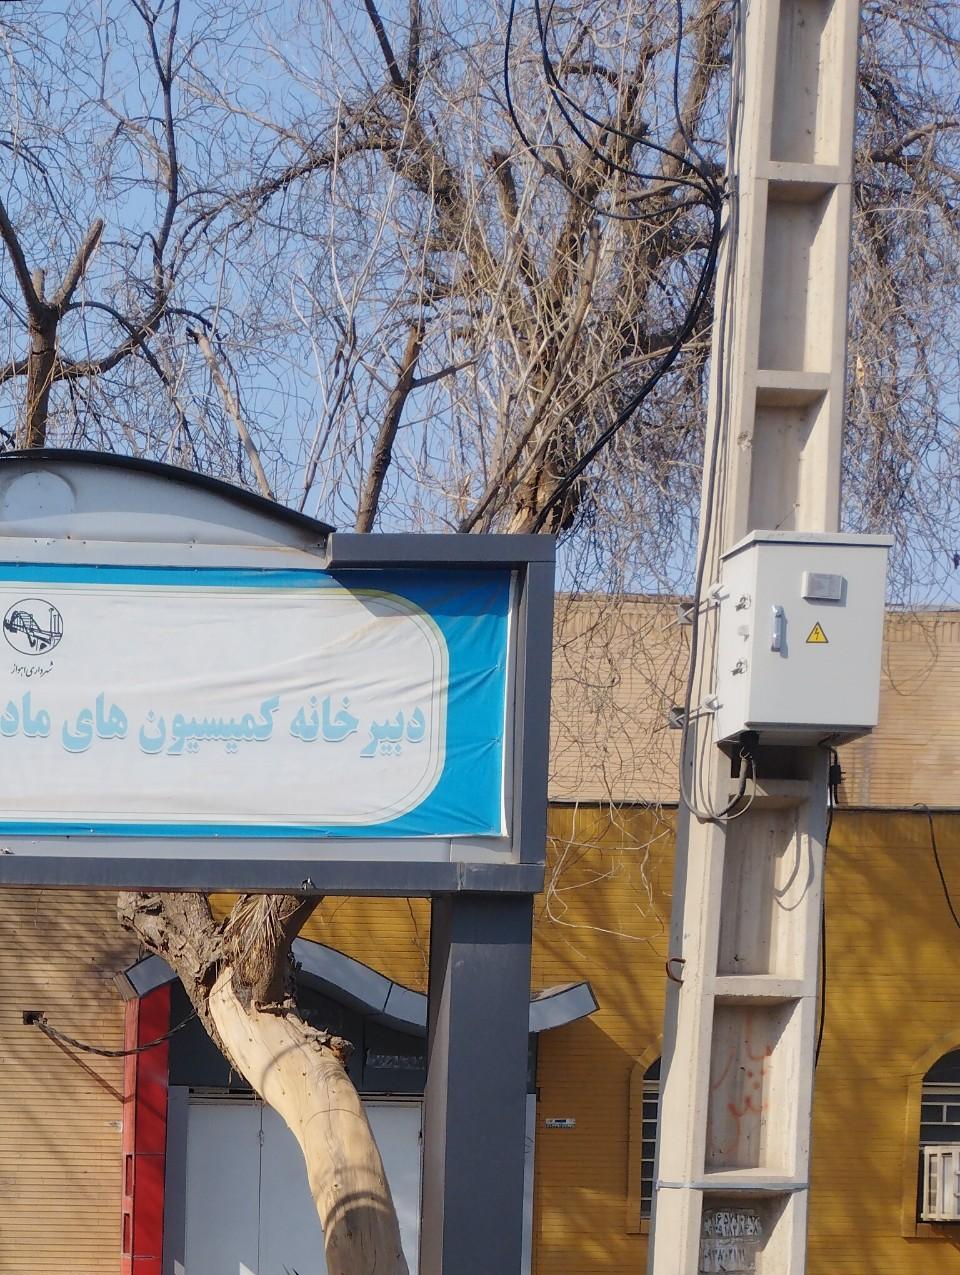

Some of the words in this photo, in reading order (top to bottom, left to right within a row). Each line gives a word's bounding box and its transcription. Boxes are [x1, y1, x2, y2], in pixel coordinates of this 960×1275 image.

[11, 663, 27, 678] اهواز
[26, 660, 54, 679] شهرداری
[61, 692, 129, 754] های
[138, 695, 281, 756] کمیسیون
